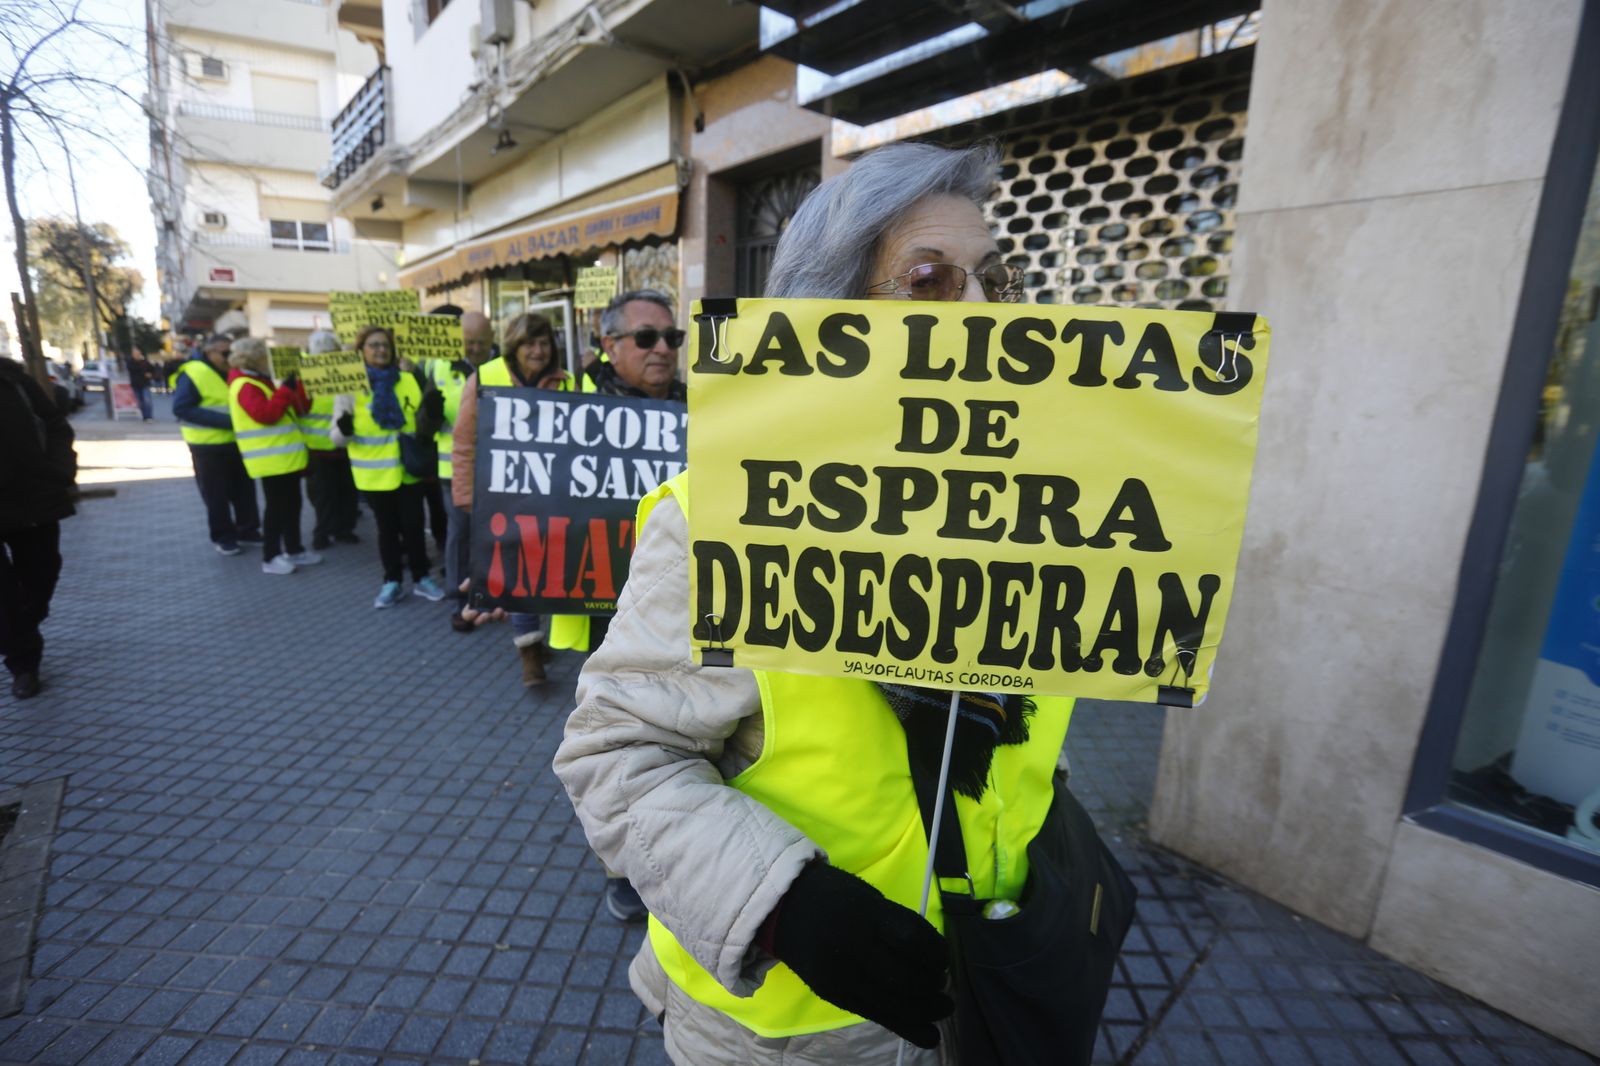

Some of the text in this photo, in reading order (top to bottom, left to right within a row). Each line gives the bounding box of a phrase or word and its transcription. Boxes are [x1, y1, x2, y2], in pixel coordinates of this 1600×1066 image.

[528, 226, 579, 254] BAZAR
[394, 313, 461, 327] UNIDOS
[408, 326, 449, 337] POR LA
[395, 336, 463, 348] SANIDAD
[691, 312, 1254, 396] LAS LISTAS
[894, 397, 1019, 458] DE
[487, 449, 556, 495] EN
[740, 459, 1173, 552] ESPERA
[692, 540, 1221, 677] DESESPERAN
[843, 660, 1034, 689] YAYOFLAUTAS CORDOBA
